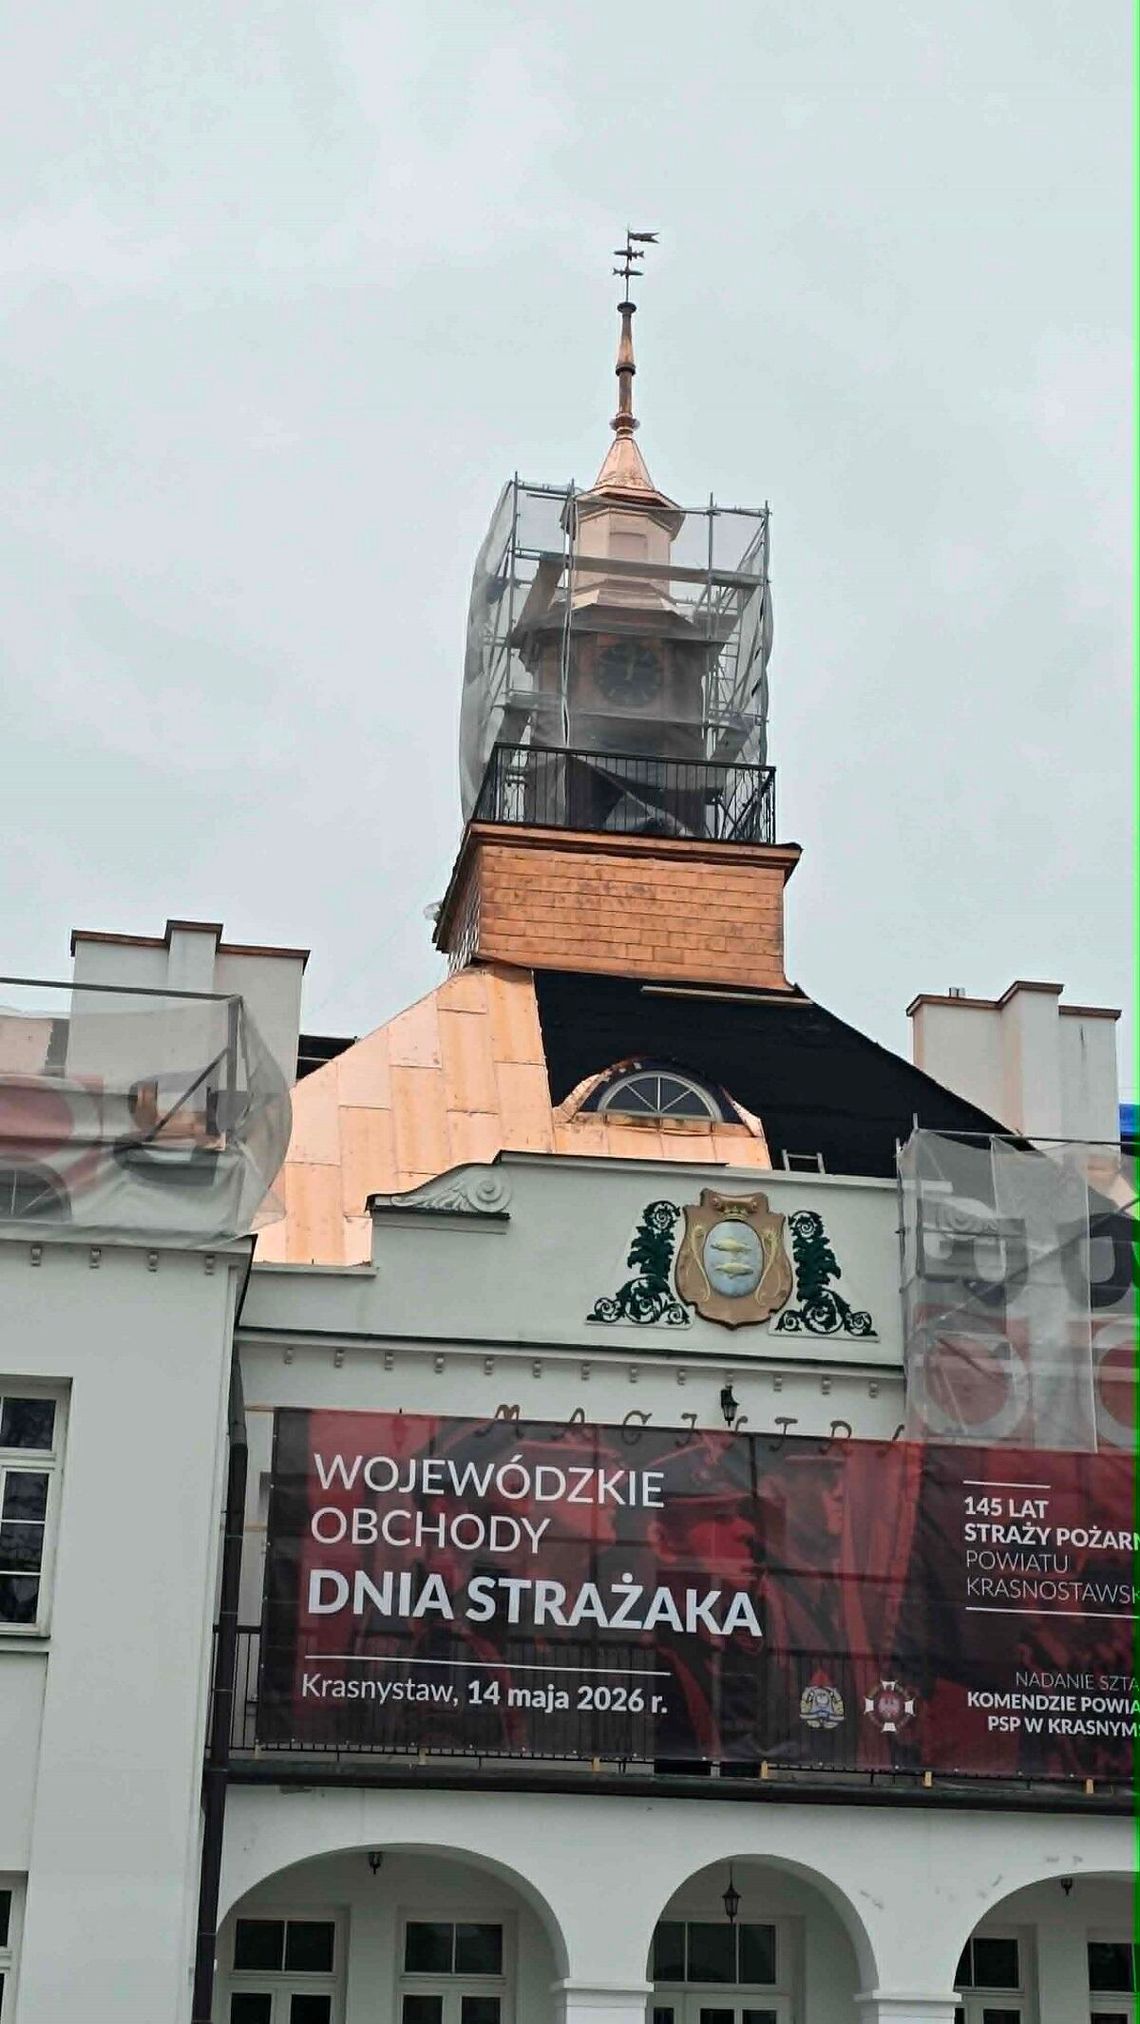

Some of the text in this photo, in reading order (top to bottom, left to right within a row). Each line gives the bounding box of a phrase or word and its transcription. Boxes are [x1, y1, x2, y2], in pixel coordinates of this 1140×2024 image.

[314, 1453, 666, 1509] WOJEWÓDZKIE
[964, 1496, 1049, 1519] 145 LAT
[310, 1506, 552, 1554] OBCHODY
[964, 1522, 1051, 1546] STRAŻY
[966, 1550, 1069, 1573] POWIATU
[307, 1568, 764, 1637] DNIA STRAŻAKA
[301, 1672, 668, 1714] Krasnystaw, 14 maja 2026 r.
[1015, 1672, 1140, 1692] NADANIE SZTA
[967, 1692, 1140, 1715] KOMENDZIE POWIA
[988, 1716, 1140, 1738] PSP W KRASNYM
